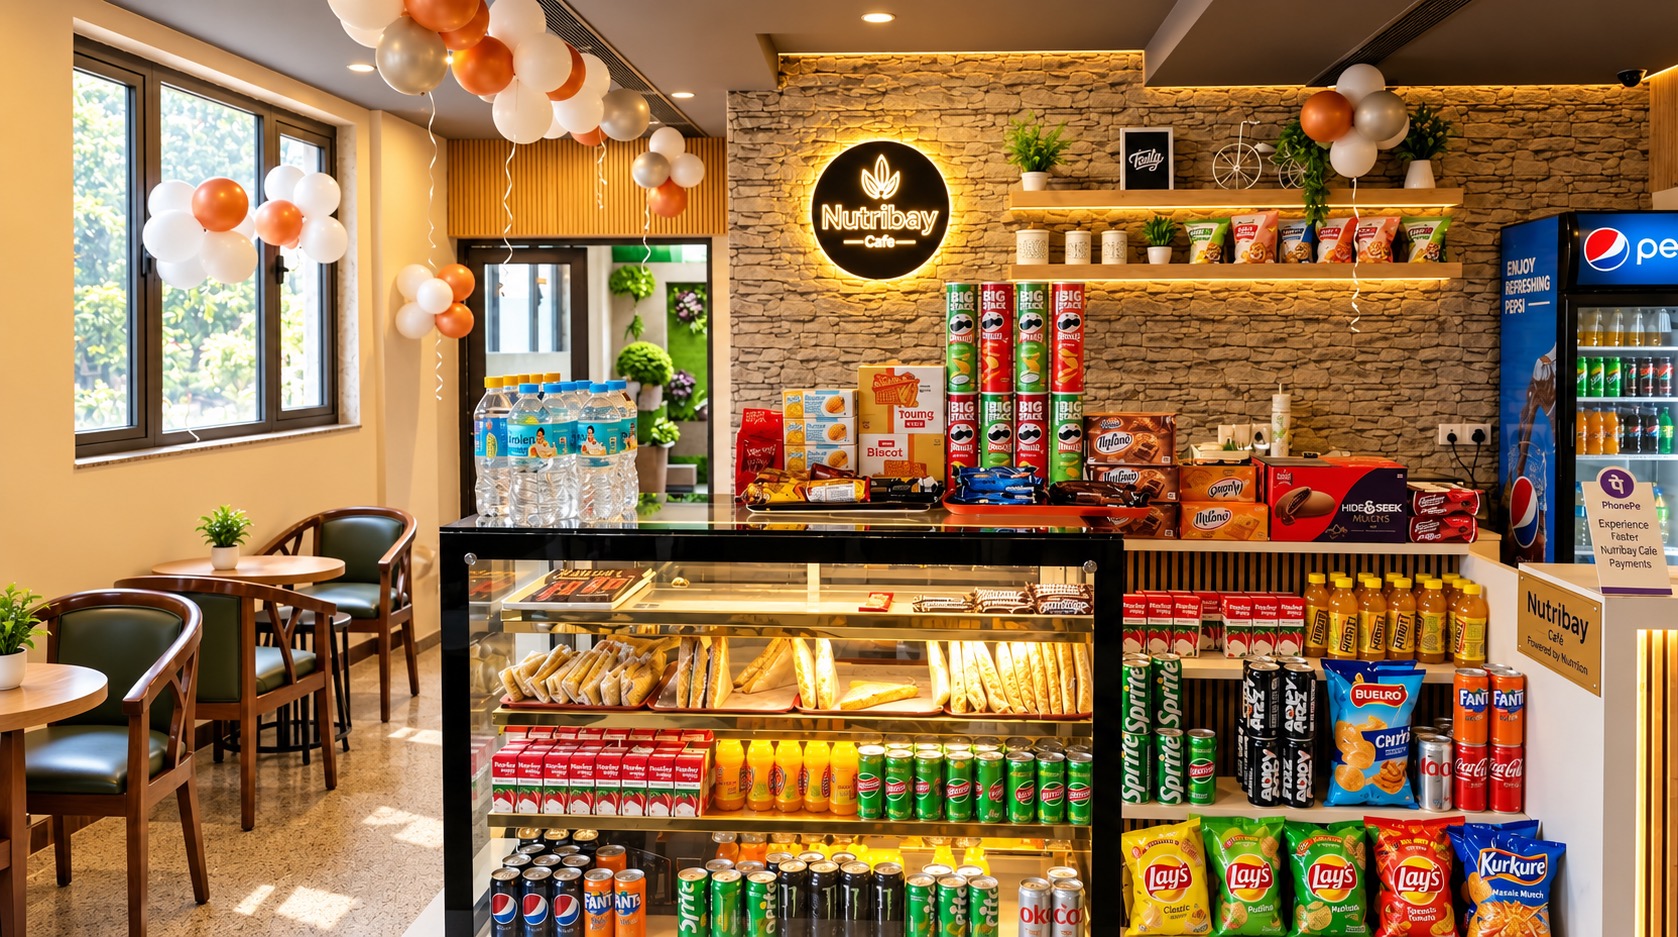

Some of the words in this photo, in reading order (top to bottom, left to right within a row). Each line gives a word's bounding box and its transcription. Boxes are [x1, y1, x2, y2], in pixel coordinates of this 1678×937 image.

[822, 204, 938, 236] Nutribay
[864, 235, 895, 248] Cafe
[1507, 257, 1536, 276] ENJOY
[1505, 275, 1550, 295] REFRESHING
[951, 291, 974, 303] BIG
[983, 290, 1006, 302] BIG
[1020, 290, 1043, 302] BIG
[1060, 291, 1082, 302] BIG
[1505, 298, 1525, 314] PEPSI
[951, 401, 974, 413] BIG
[989, 401, 1011, 413] BIG
[1019, 401, 1042, 413] BIG
[1059, 401, 1082, 413] BIG
[1602, 501, 1641, 511] PhonePe
[1598, 519, 1649, 530] Experience
[1609, 558, 1652, 570] Payments
[1527, 591, 1589, 644] Nutribay
[1355, 688, 1402, 701] BUELRO
[1481, 852, 1545, 876] Kurkure
[1149, 863, 1188, 891] Lay's
[1230, 862, 1270, 890] Lay's
[1312, 863, 1353, 889] Lay's
[1398, 865, 1440, 892] Lay's
